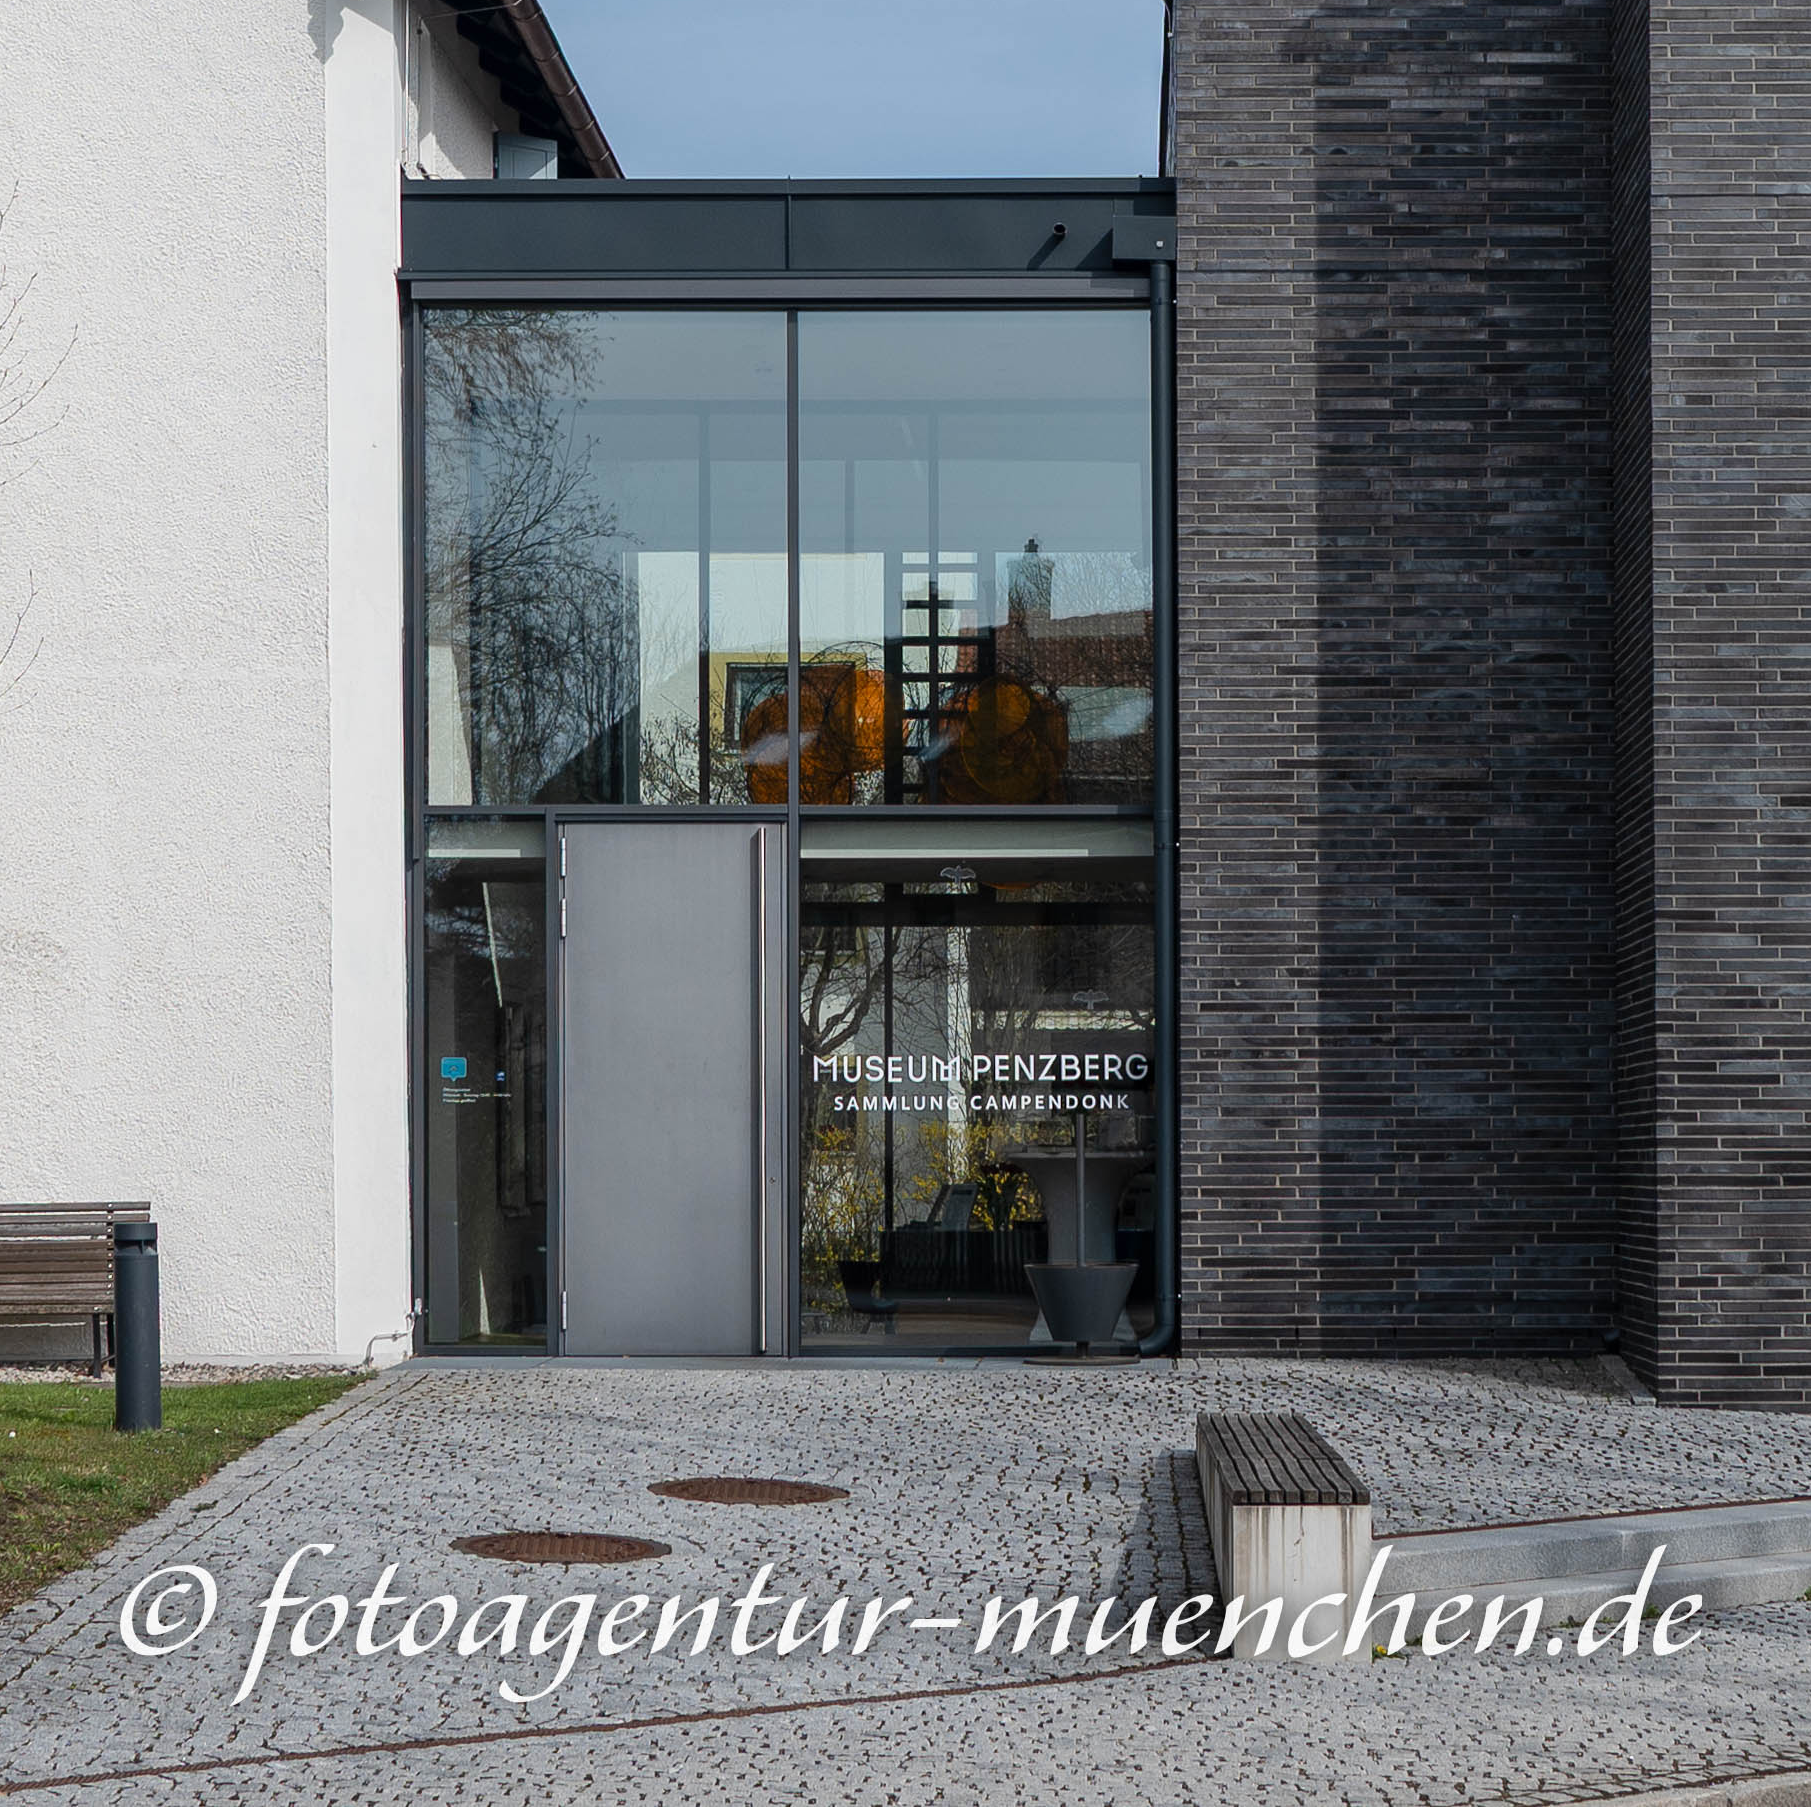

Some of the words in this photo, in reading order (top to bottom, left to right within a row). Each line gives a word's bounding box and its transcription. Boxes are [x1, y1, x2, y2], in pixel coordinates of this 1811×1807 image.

[813, 1054, 961, 1083] MUSEUM
[973, 1053, 1149, 1082] PENZBERG
[833, 1095, 960, 1111] SAMMLUNG
[970, 1094, 1130, 1111] CAMPENDONK
